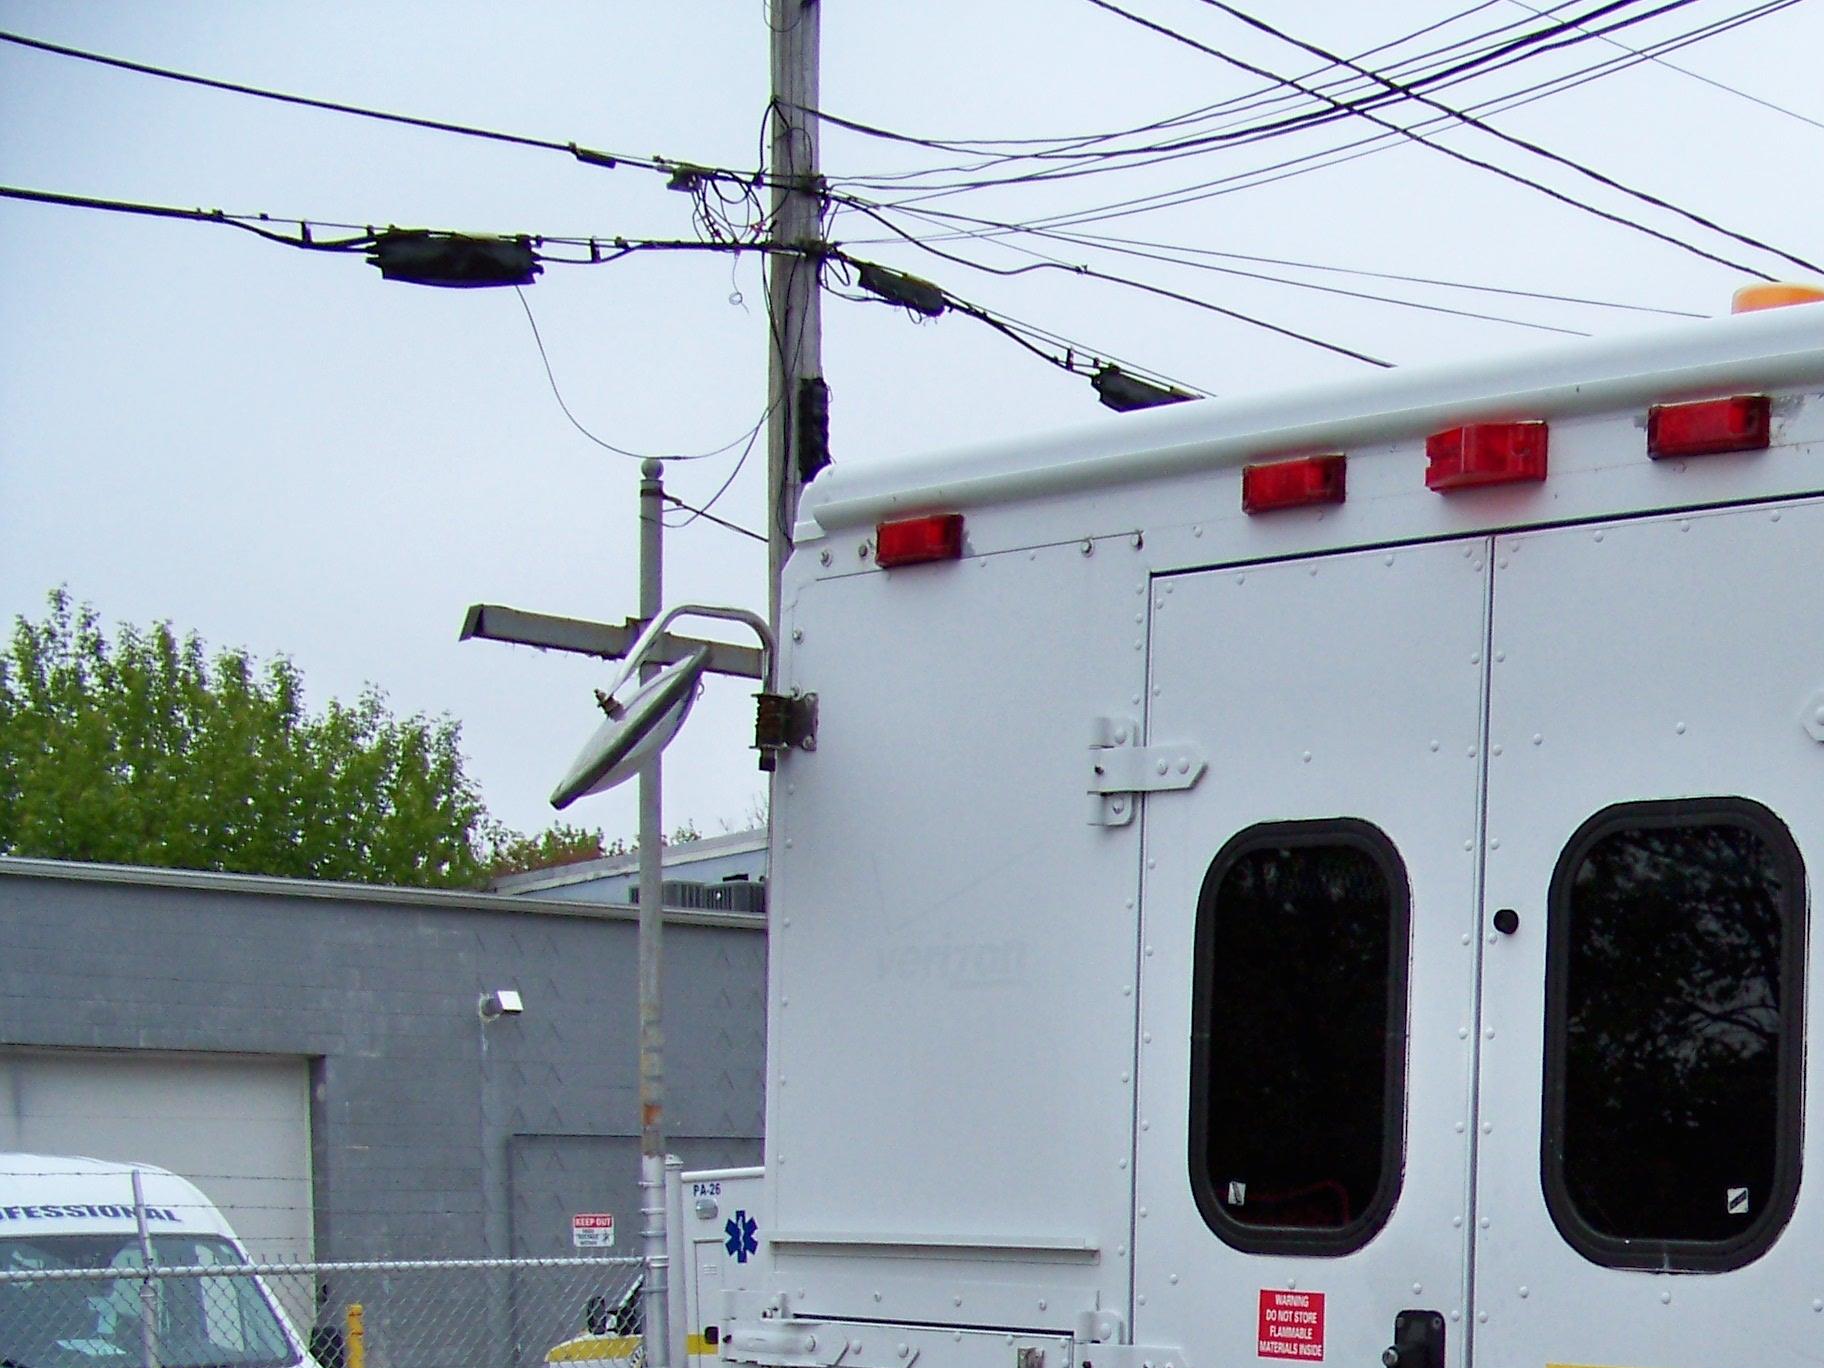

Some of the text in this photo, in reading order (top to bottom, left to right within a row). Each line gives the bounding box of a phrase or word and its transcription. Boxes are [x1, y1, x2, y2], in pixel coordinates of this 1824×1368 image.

[693, 1183, 721, 1197] PA-26
[575, 1217, 611, 1227] KEEP OUT
[1275, 1294, 1309, 1307] WARNING
[1266, 1309, 1317, 1324] DO NOT STORE
[1270, 1325, 1312, 1339] FLAMMABLE
[1260, 1341, 1322, 1356] MATERIALS INSIDE
